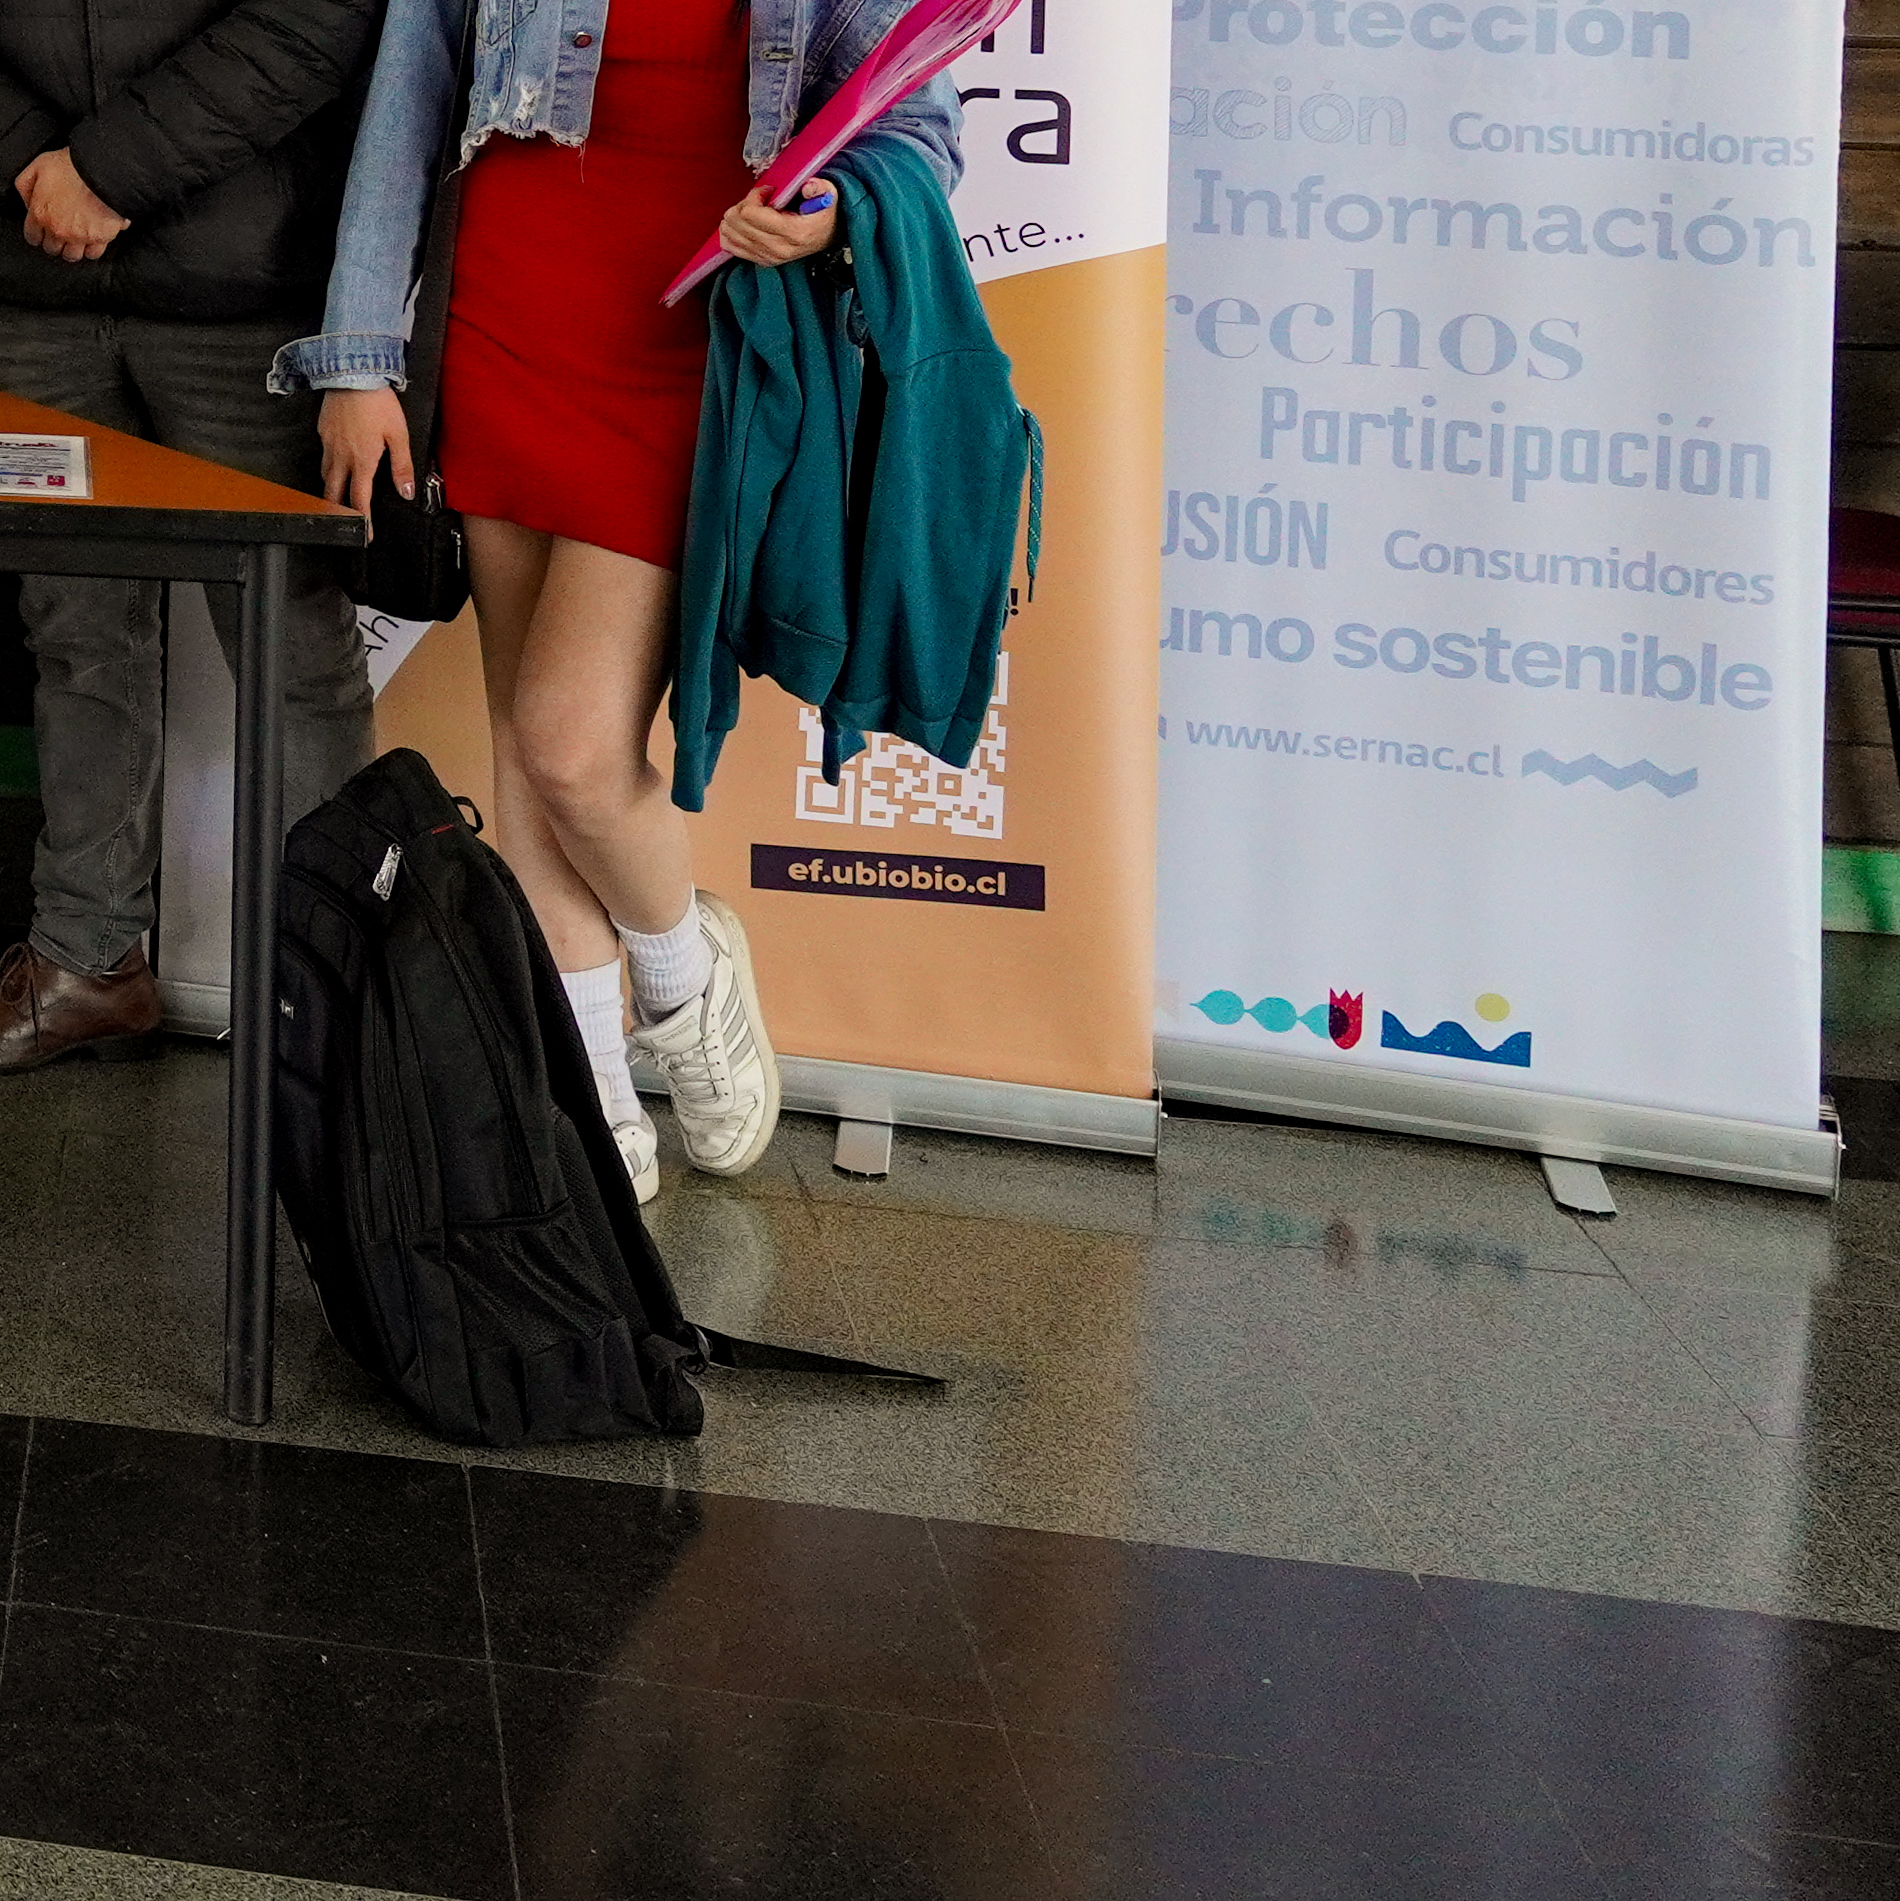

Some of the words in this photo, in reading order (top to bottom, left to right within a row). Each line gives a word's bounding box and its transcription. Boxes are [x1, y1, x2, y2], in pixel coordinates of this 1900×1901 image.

[1169, 76, 1407, 147] ación
[1449, 111, 1815, 169] Consumidoras
[1192, 167, 1815, 268] Información
[1164, 267, 1584, 382] rechos
[1260, 385, 1771, 502] Participación
[1383, 529, 1775, 605] Consumidores
[1333, 621, 1773, 711] sostenible
[1186, 714, 1504, 778] www.sernac.cl
[787, 858, 1006, 896] ef.ubiobio.cl
